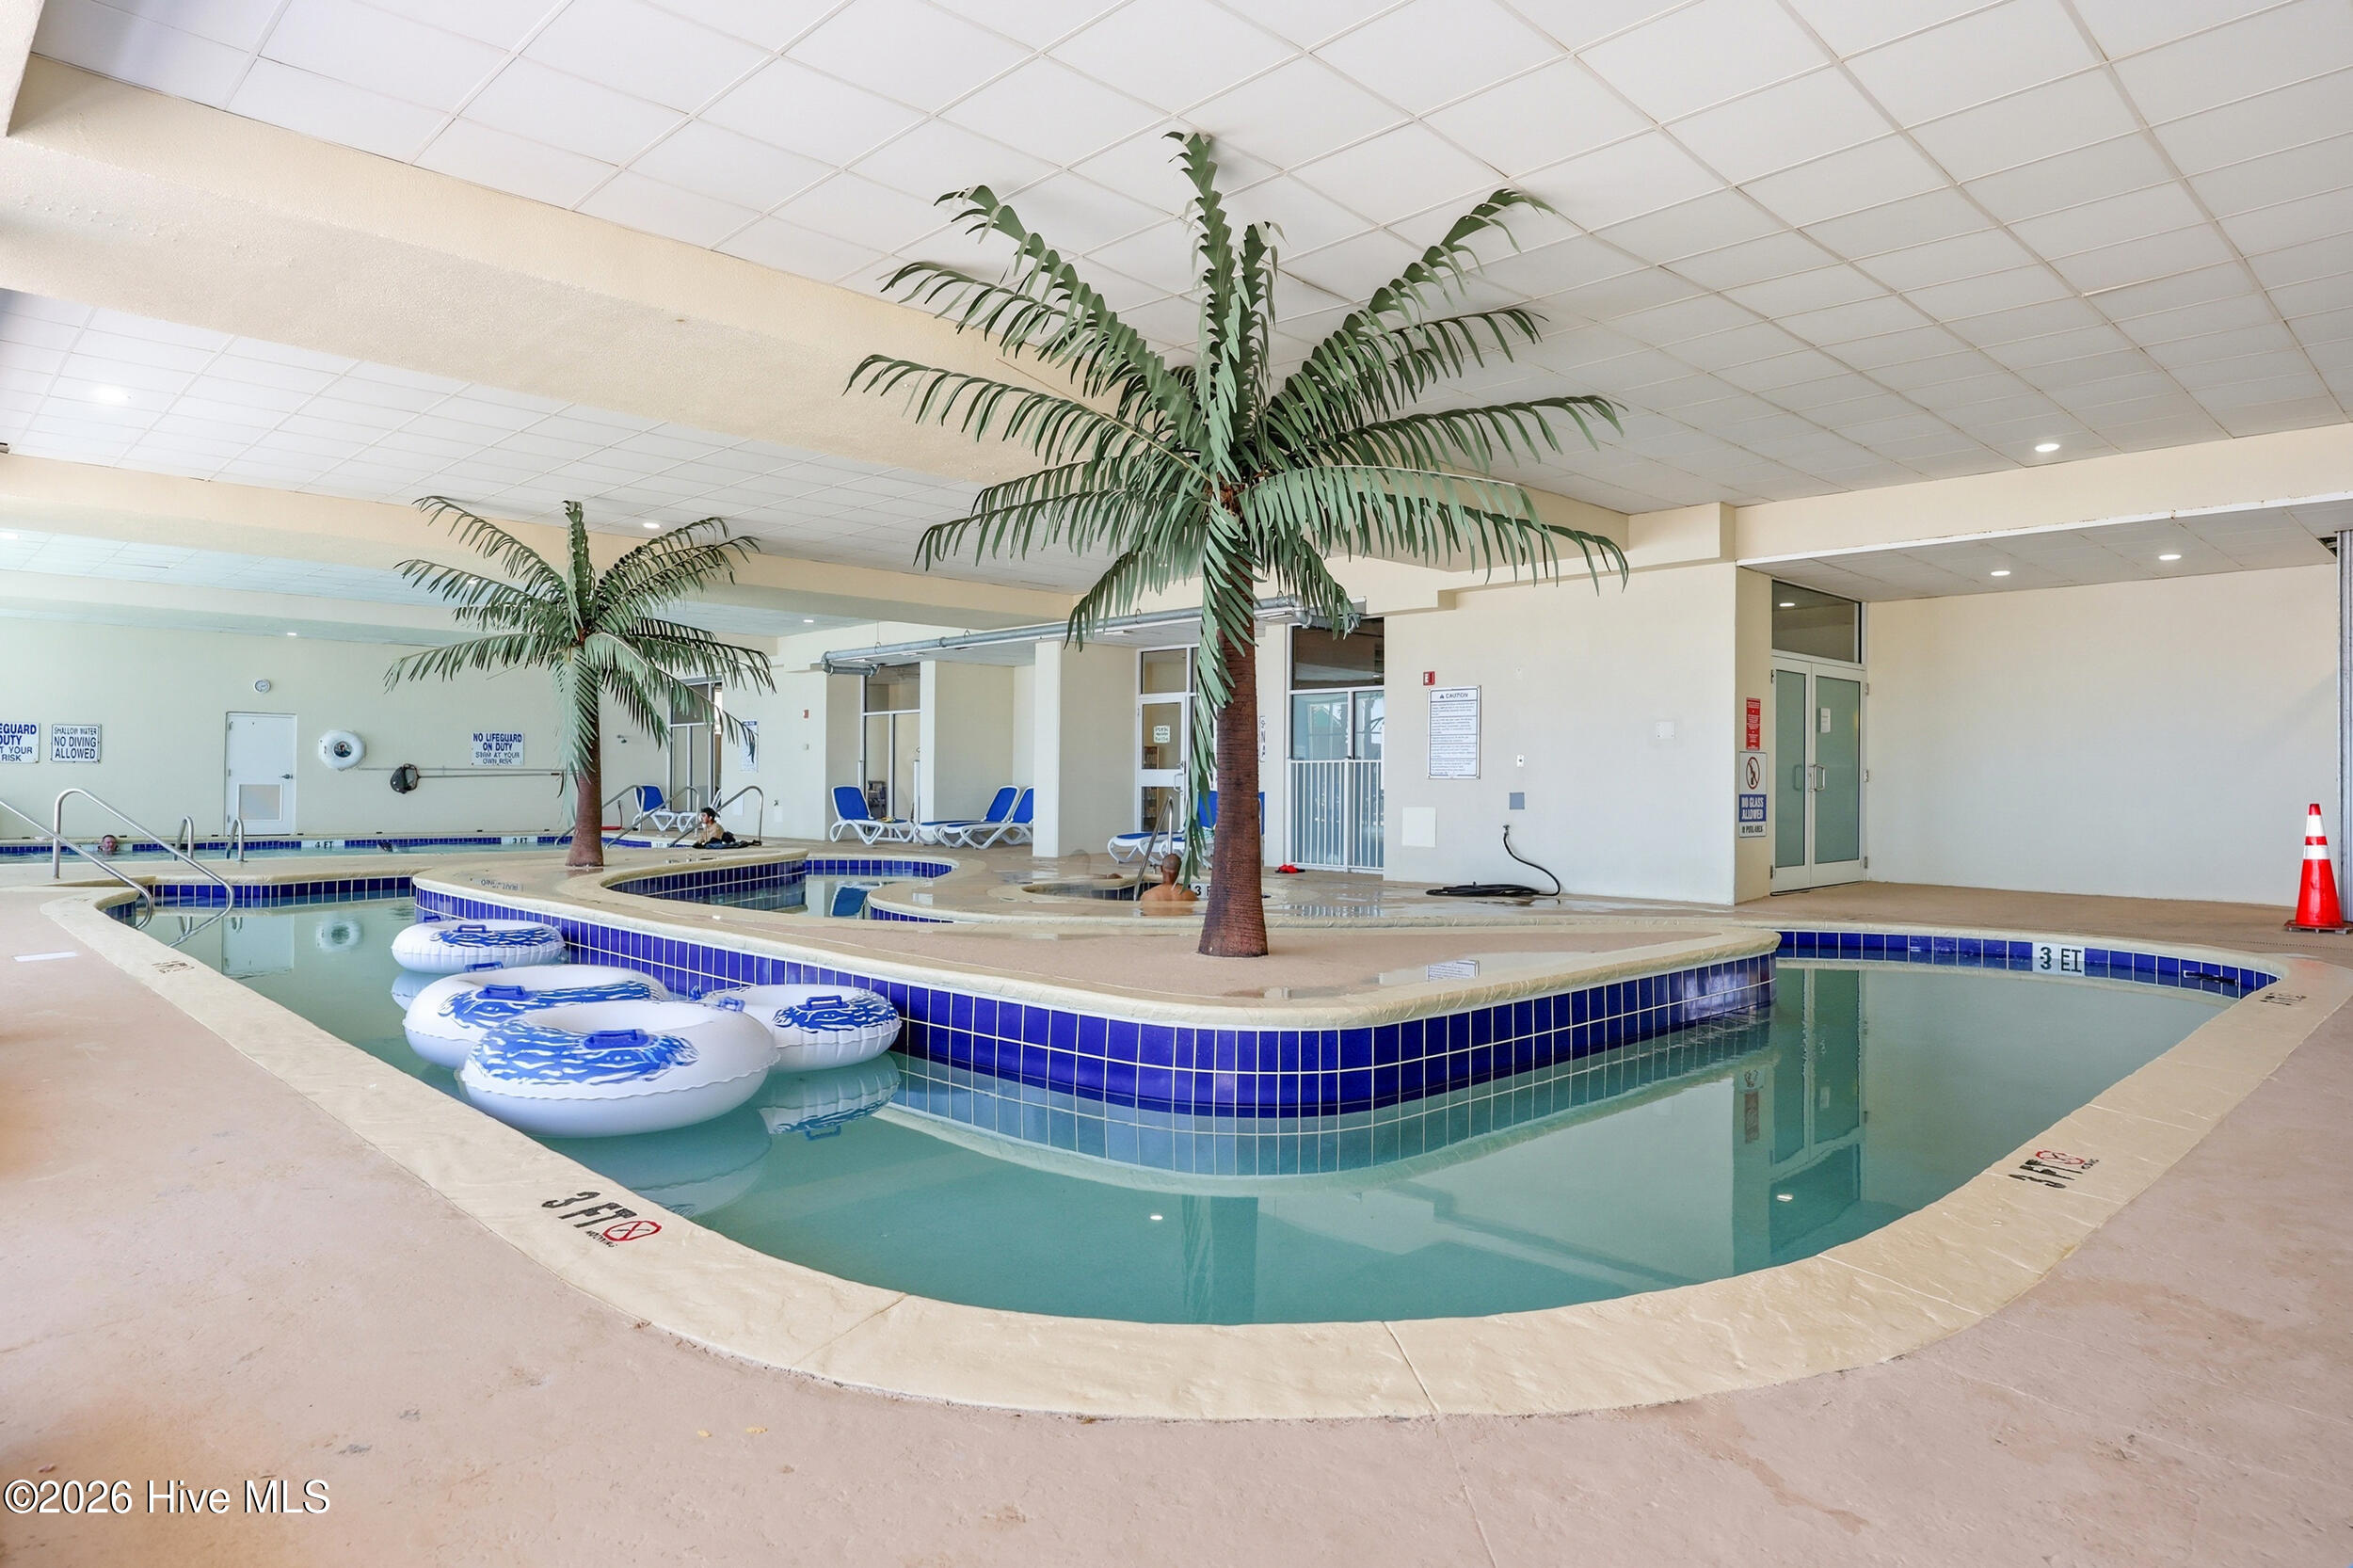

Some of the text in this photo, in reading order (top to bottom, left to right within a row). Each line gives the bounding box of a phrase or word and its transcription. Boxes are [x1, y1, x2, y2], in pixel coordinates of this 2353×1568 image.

[54, 736, 97, 747] NO DIVING
[473, 733, 522, 743] NO LIFEGUARD
[483, 743, 512, 751] ON DUTY
[55, 748, 96, 759] ALLOWED
[324, 840, 334, 849] FT
[1194, 886, 1210, 896] 3 F
[541, 1192, 637, 1228] 3 FT
